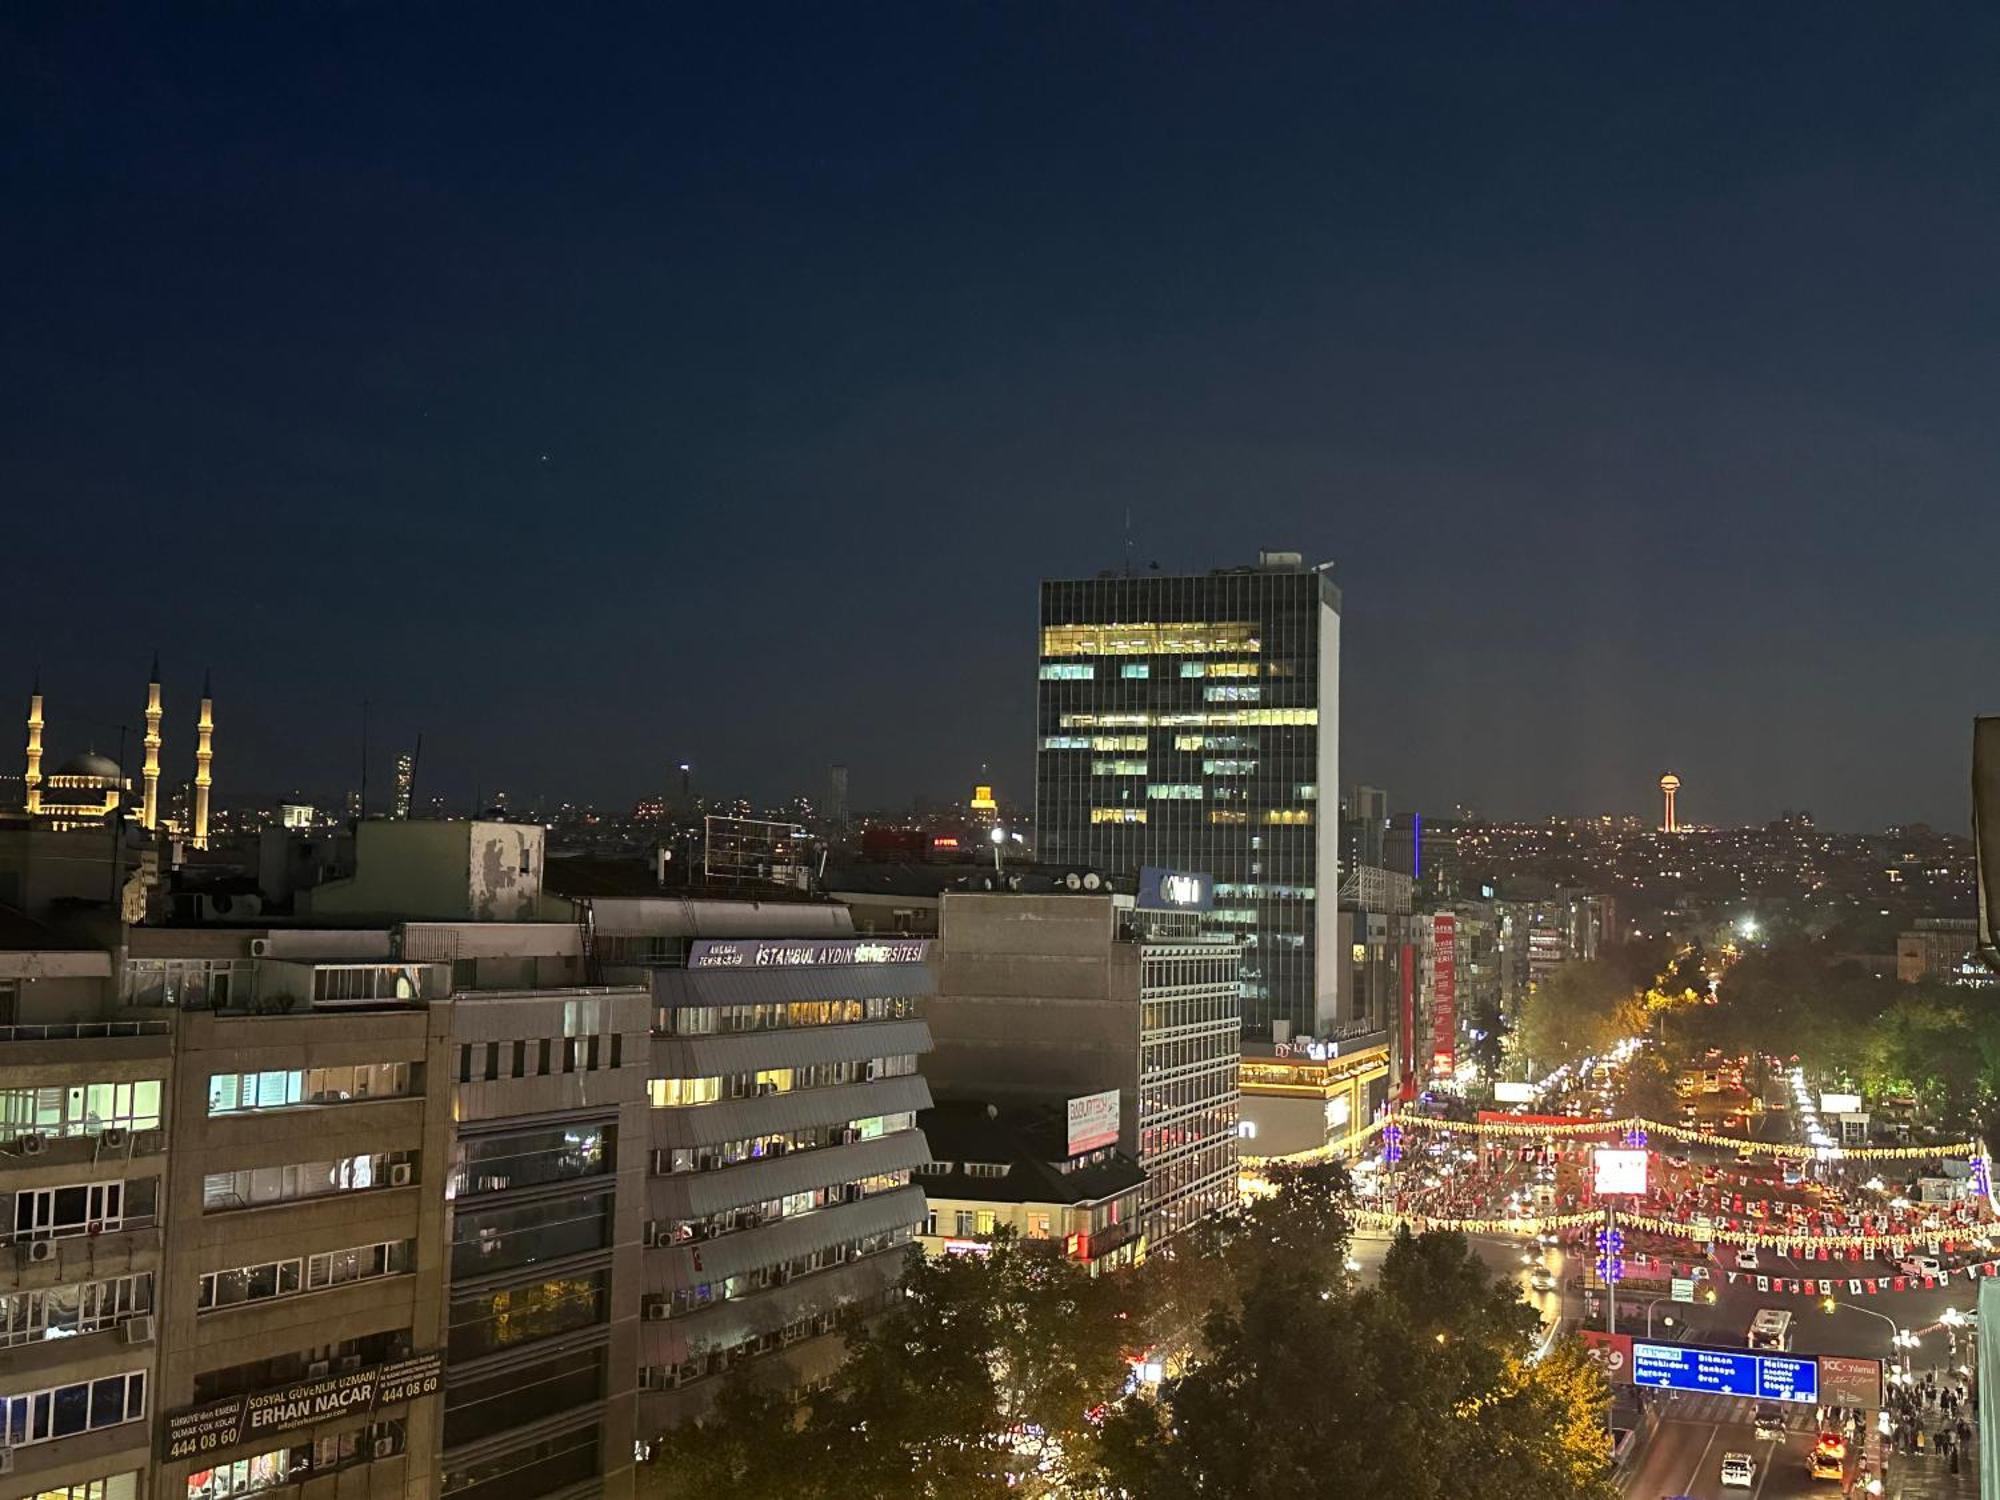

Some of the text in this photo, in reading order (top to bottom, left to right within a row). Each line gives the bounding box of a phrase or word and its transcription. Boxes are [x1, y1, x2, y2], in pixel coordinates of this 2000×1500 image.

[756, 943, 814, 965] İSTANBUL
[818, 947, 853, 964] AYDIN
[249, 1392, 287, 1409] SOSYAL
[382, 1386, 404, 1402] 444
[406, 1381, 421, 1397] 08
[423, 1376, 437, 1392] 60
[251, 1384, 371, 1428] ERHAN NACAR
[169, 1427, 237, 1457] 444 08 60
